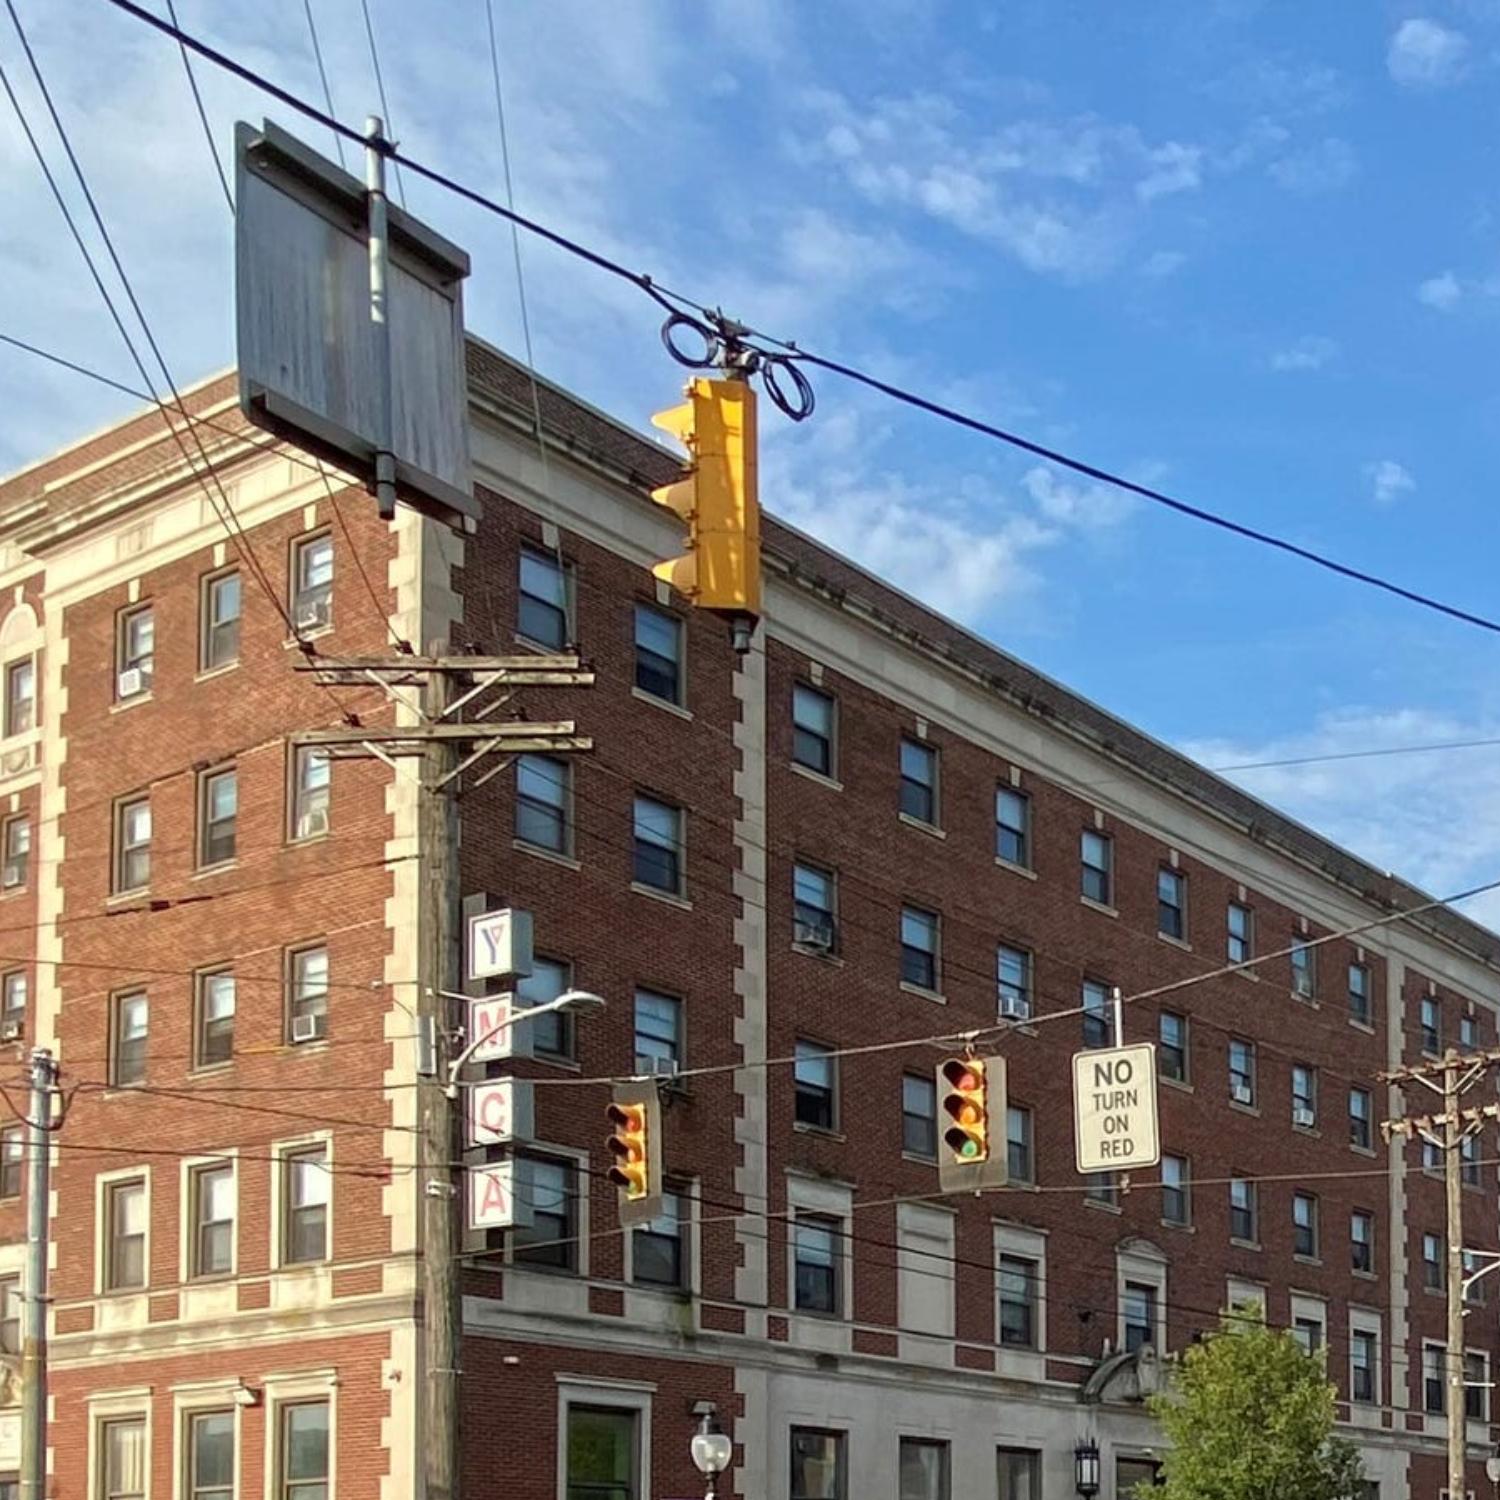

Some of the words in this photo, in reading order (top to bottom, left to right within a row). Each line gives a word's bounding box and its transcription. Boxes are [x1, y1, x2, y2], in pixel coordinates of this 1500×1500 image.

[1094, 1059, 1133, 1087] NO
[1093, 1089, 1138, 1112] TURN
[1103, 1114, 1129, 1134] ON
[1100, 1138, 1135, 1159] RED
